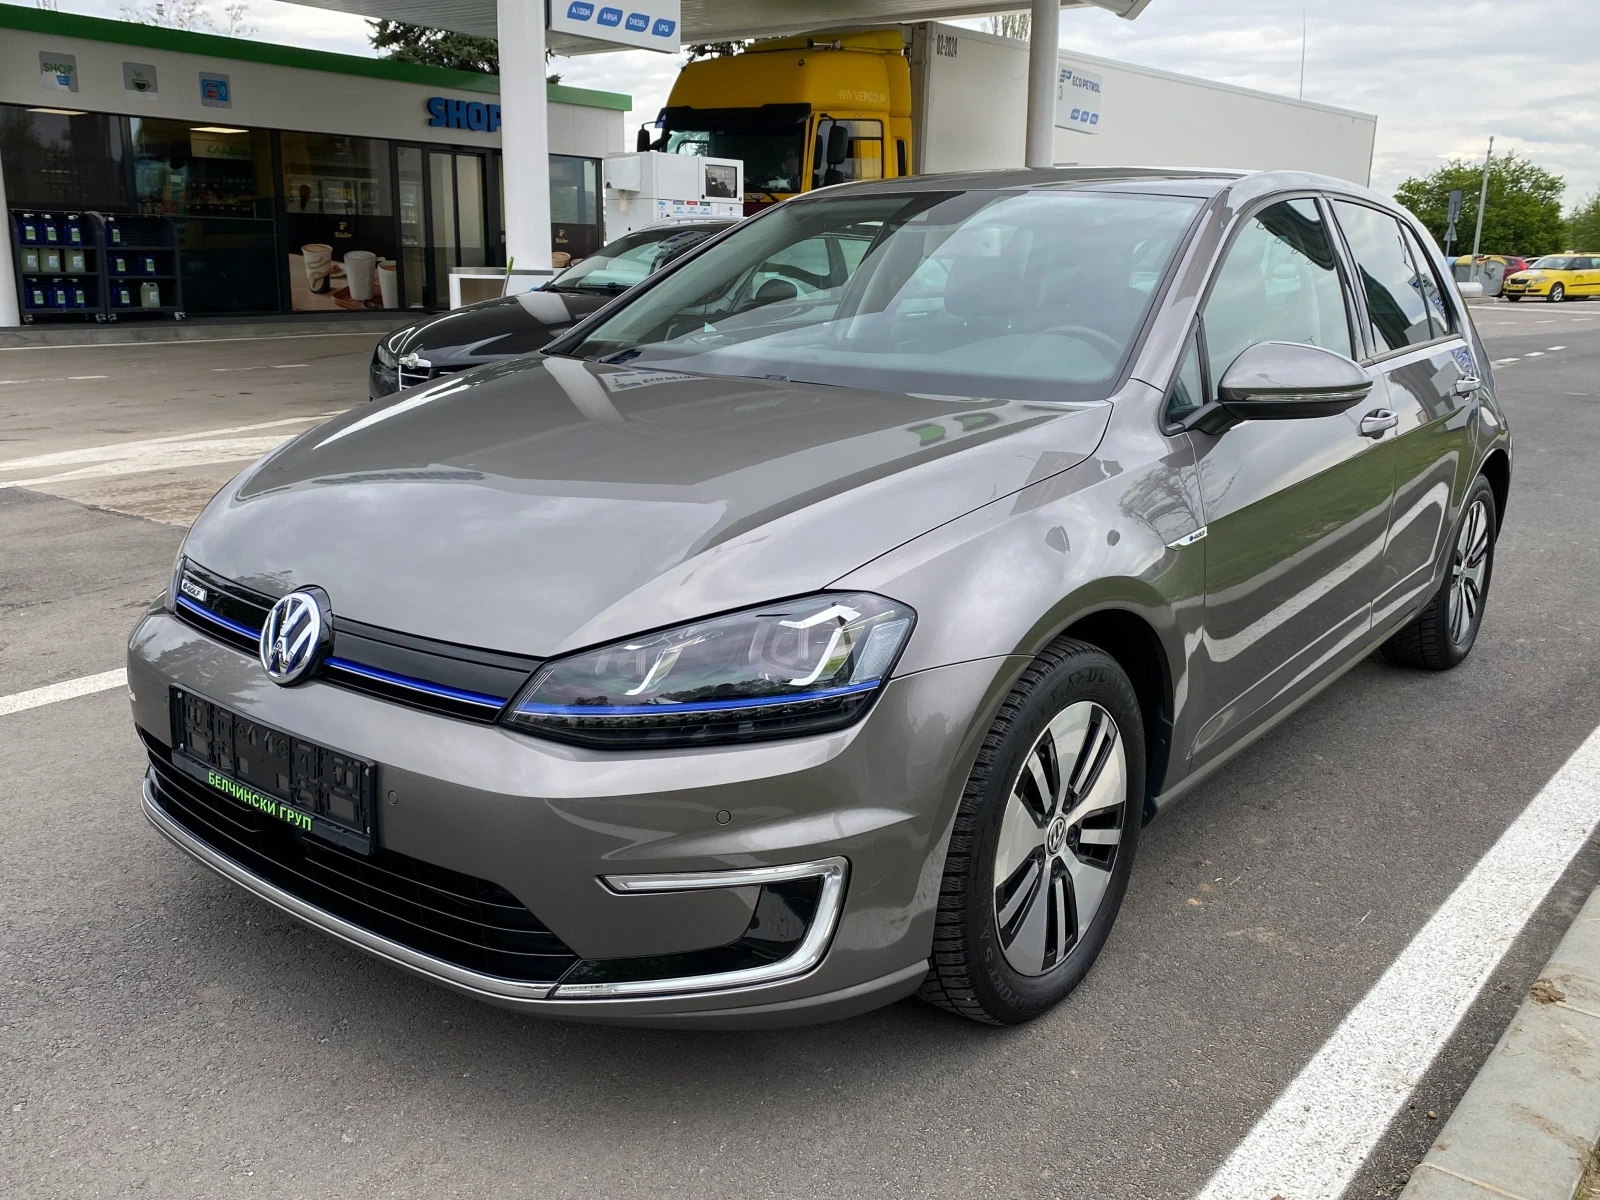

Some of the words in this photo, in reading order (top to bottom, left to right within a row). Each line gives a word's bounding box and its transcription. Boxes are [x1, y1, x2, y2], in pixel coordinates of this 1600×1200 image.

[571, 6, 591, 17] A100H
[629, 17, 646, 28] DIESEL
[658, 23, 669, 33] LPG
[936, 33, 958, 59] 02-2024
[42, 62, 74, 75] SHOP
[427, 96, 502, 133] SHOP
[208, 771, 276, 816] БЕЛЧИНСКИ
[279, 806, 312, 831] ГРУП
